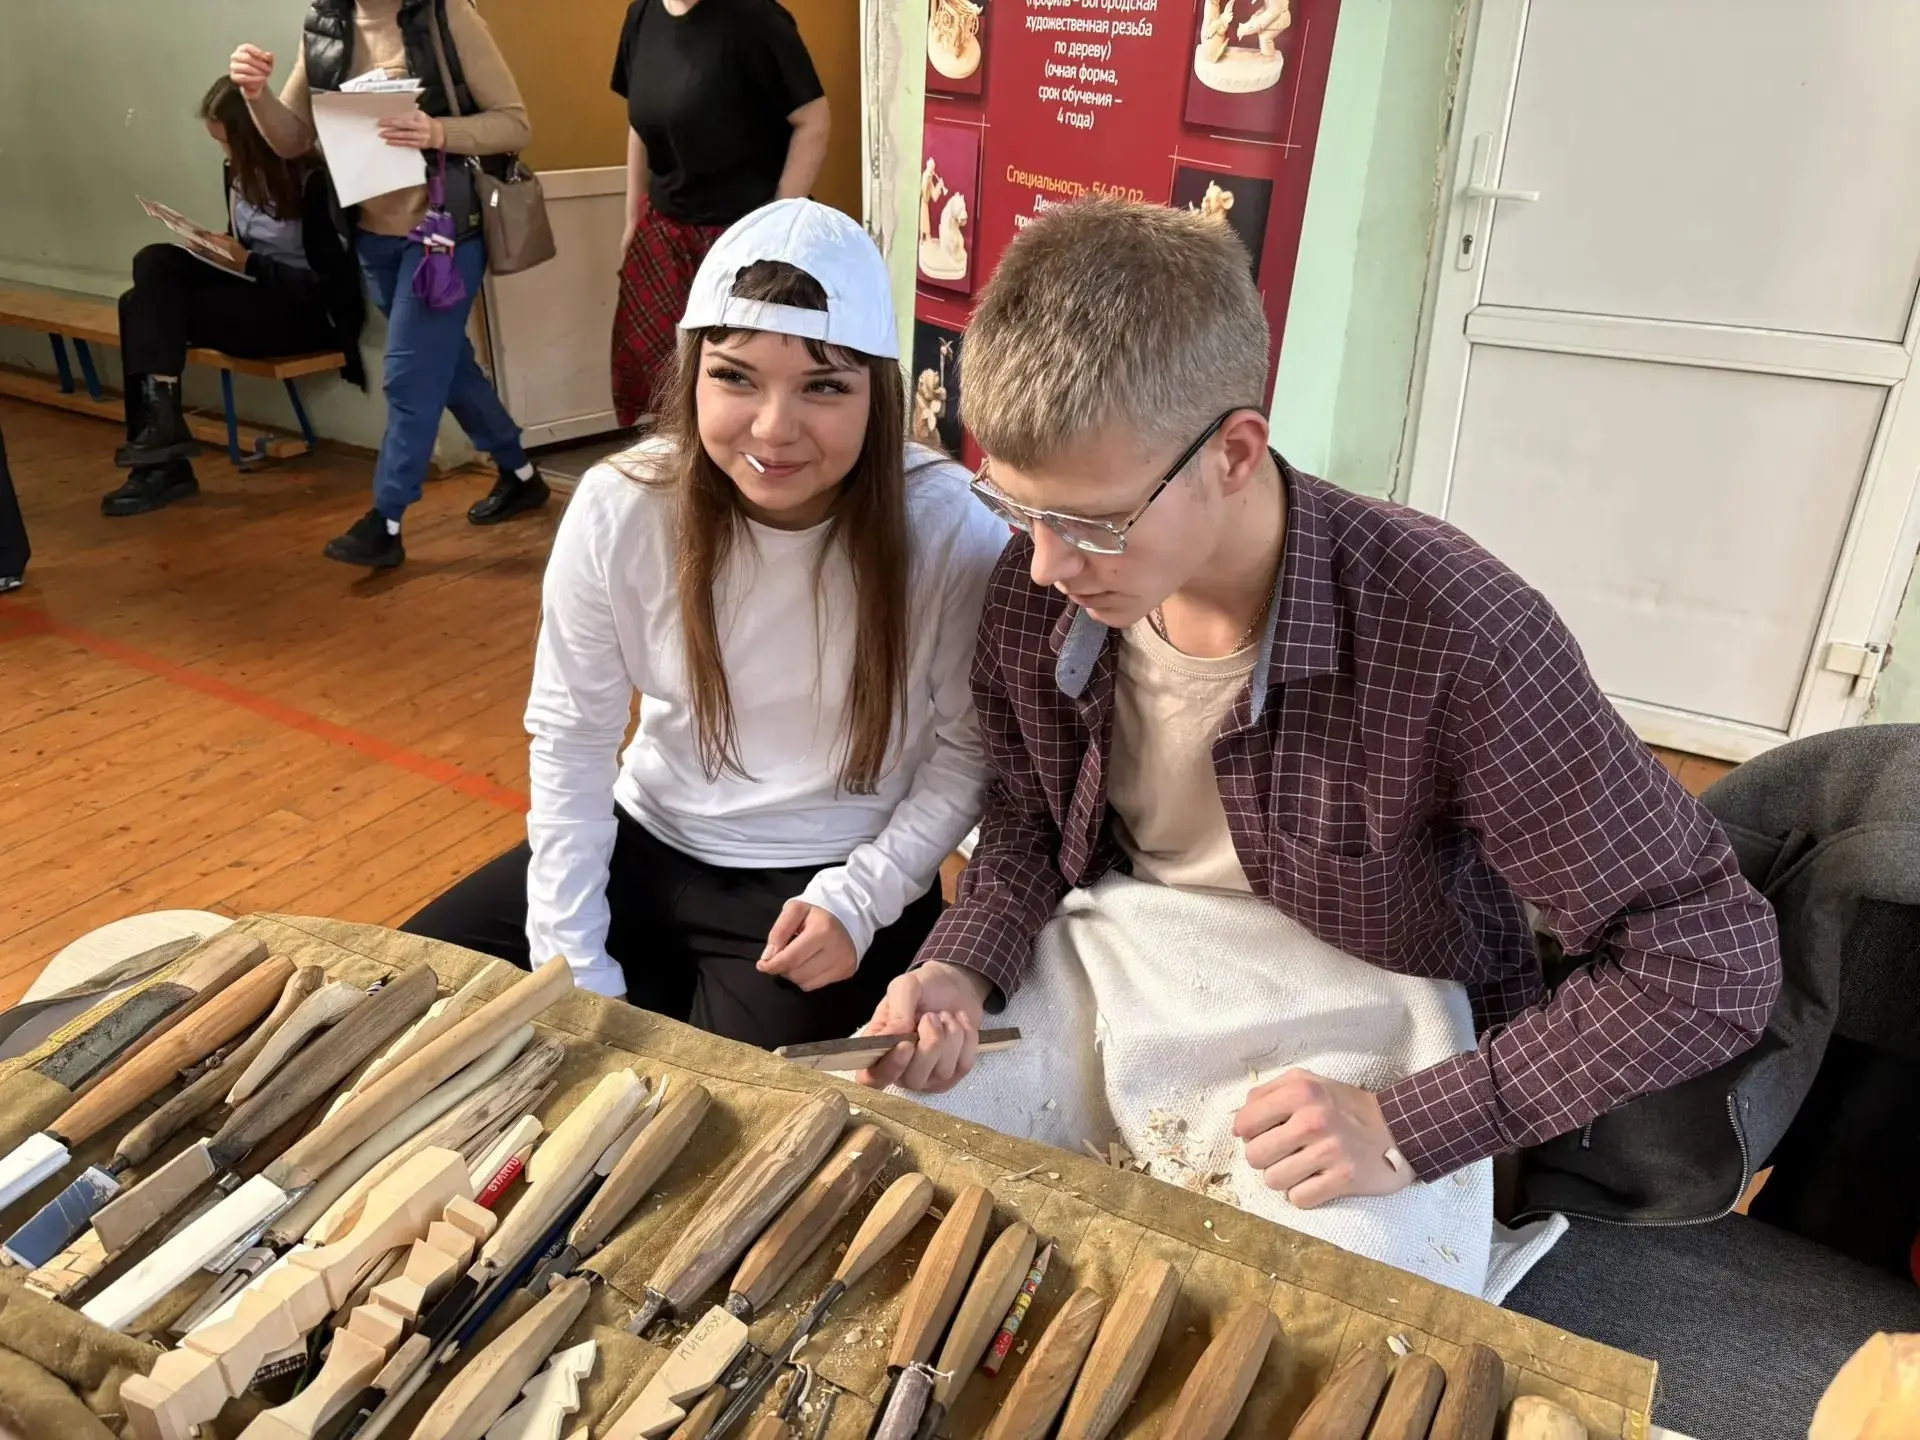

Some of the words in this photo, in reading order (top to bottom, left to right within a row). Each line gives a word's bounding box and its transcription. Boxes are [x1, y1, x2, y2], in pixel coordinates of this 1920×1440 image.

[1025, 15, 1109, 33] художественная
[1111, 17, 1153, 38] резьба
[1054, 41, 1067, 54] по
[1068, 40, 1112, 62] дереву)
[1045, 59, 1077, 78] (очная
[1079, 63, 1118, 86] форма,
[1038, 85, 1060, 102] срок
[1062, 84, 1112, 107] обучения
[1057, 106, 1064, 123] 4
[1065, 110, 1095, 130] года)
